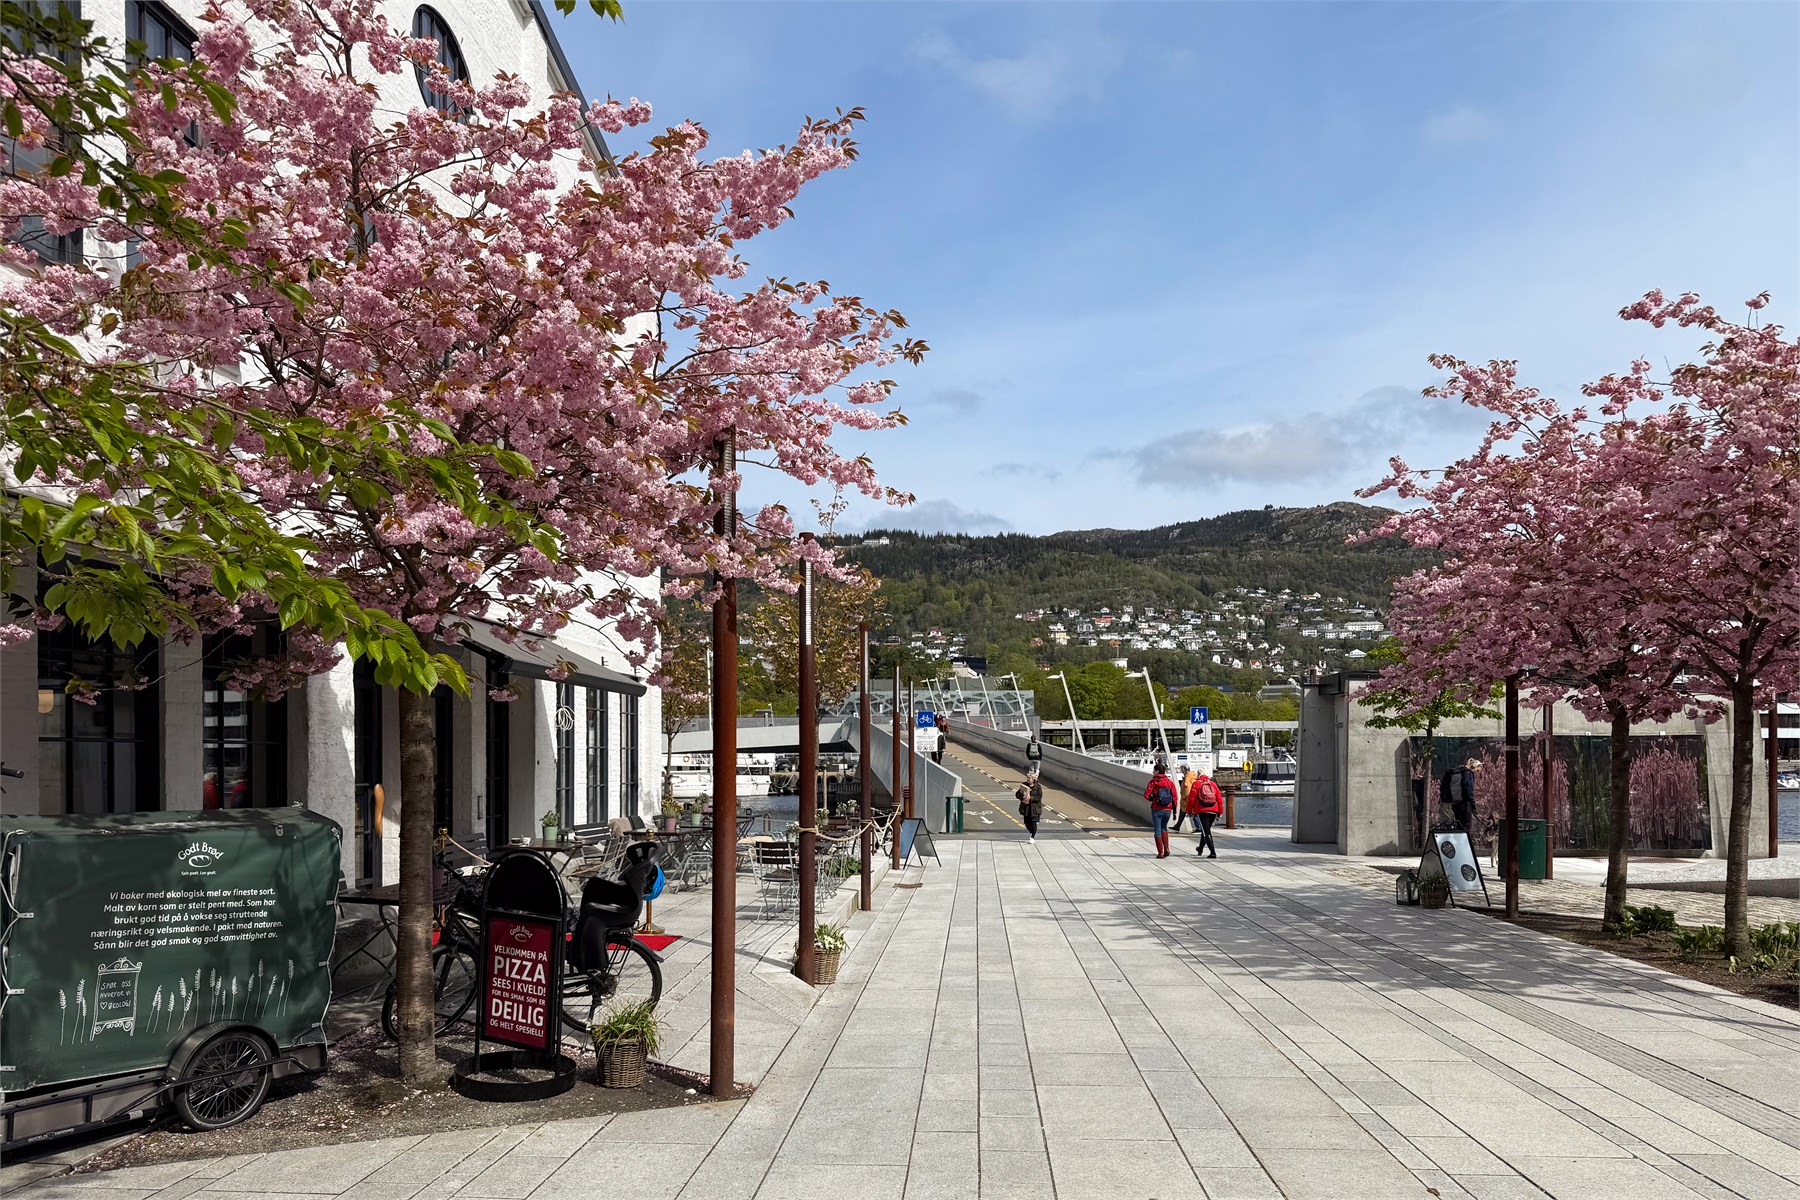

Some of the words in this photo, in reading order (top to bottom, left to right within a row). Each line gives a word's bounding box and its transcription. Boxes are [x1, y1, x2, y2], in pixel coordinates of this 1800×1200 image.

[178, 842, 200, 860] Godt
[201, 841, 224, 859] Brød
[110, 892, 119, 900] Vi
[120, 892, 144, 900] baker
[166, 890, 205, 899] økologisk
[207, 889, 221, 897] mel
[233, 888, 257, 896] fineste
[104, 904, 124, 912] Malt
[138, 903, 157, 911] korn
[208, 901, 225, 910] pent
[114, 916, 138, 924] brukt
[140, 915, 156, 925] god
[158, 914, 169, 922] tid
[171, 913, 182, 923] på
[183, 912, 188, 921] å
[214, 913, 227, 921] seg
[229, 910, 268, 919] struttende
[90, 927, 142, 938] næringsrikt
[156, 924, 211, 934] velsmakende.
[217, 923, 234, 932] pakt
[93, 941, 116, 949] Sånn
[118, 940, 133, 948] blir
[135, 939, 149, 947] det
[151, 938, 167, 948] god
[169, 937, 190, 945] smak
[204, 935, 219, 945] god
[220, 932, 267, 942] samvittighet
[494, 944, 536, 959] VELKOMMEN
[538, 951, 548, 962] PÅ
[494, 955, 546, 984] PIZZA
[492, 977, 511, 990] SEES
[517, 982, 546, 997] KVELD!
[511, 993, 525, 1001] SMAK
[526, 996, 537, 1004] SOM
[491, 998, 544, 1027] DEILIG
[490, 1019, 499, 1027] OG
[500, 1021, 514, 1030] HELT
[515, 1025, 543, 1037] SPESIELL!
